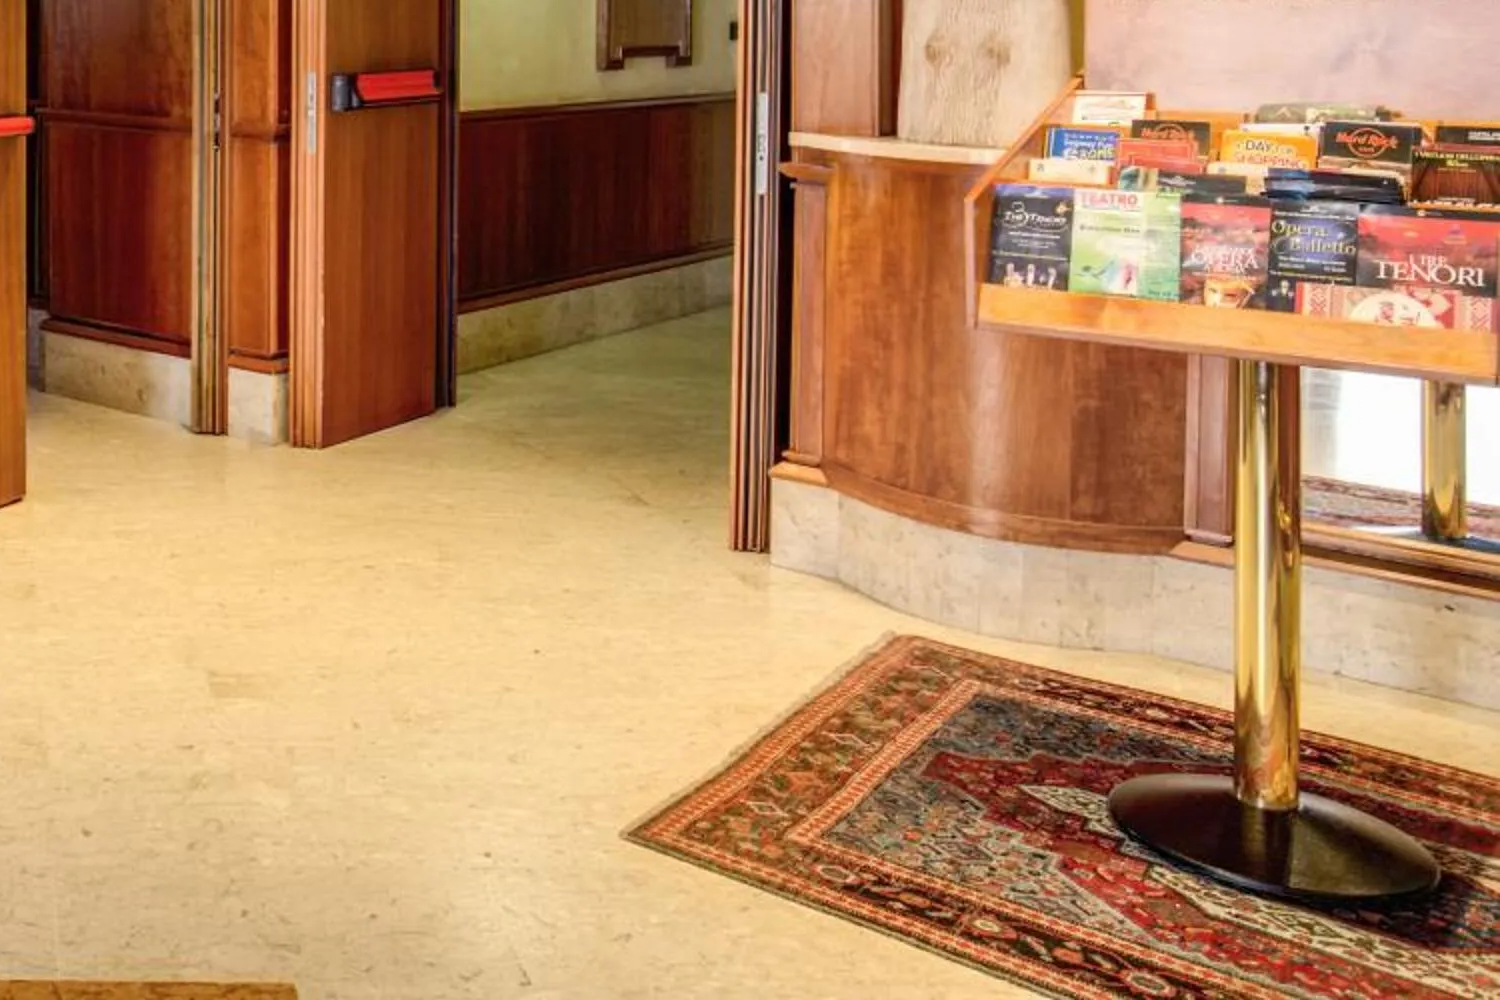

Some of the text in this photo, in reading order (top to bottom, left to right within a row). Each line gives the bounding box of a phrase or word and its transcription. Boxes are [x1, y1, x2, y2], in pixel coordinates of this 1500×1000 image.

[1245, 139, 1271, 151] DAY
[1081, 193, 1138, 207] TEATRO
[1271, 219, 1326, 238] Opera
[1372, 258, 1486, 288] TENORI
